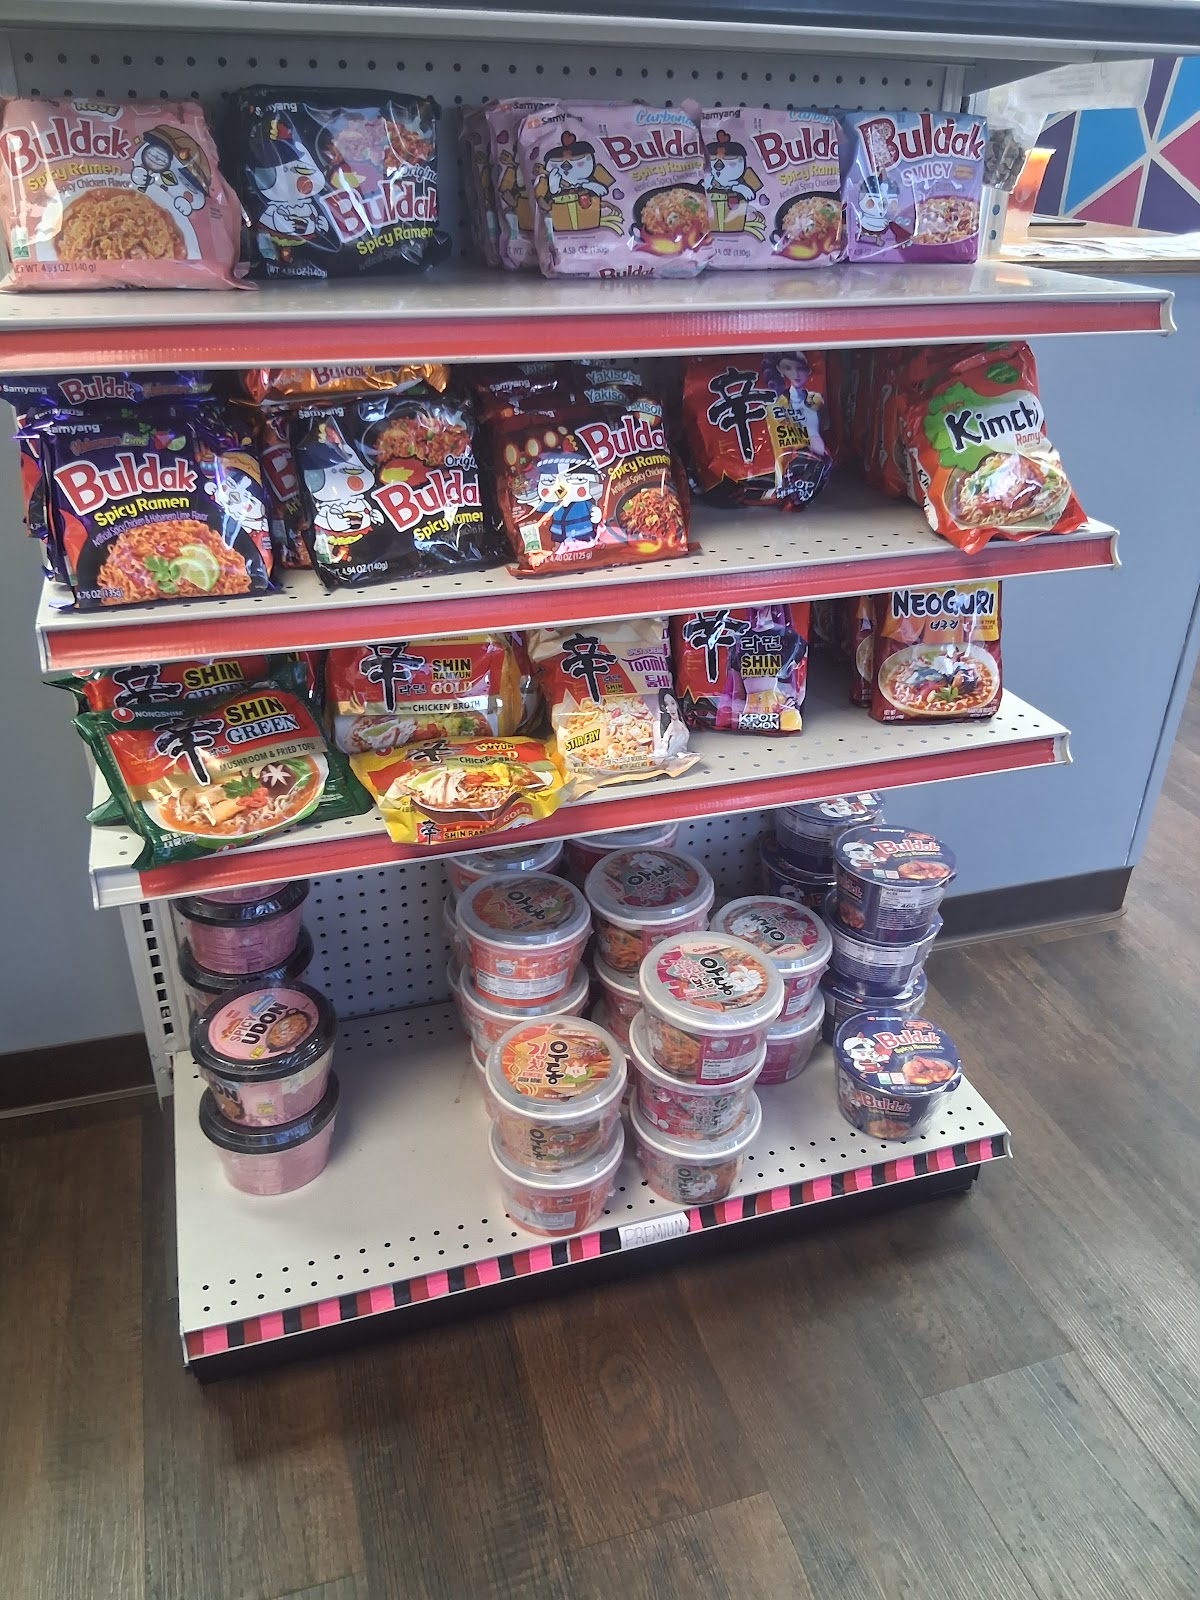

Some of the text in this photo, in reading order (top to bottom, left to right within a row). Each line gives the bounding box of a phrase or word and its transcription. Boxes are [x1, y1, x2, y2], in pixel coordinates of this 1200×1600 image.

[0, 117, 131, 179] Buldak
[857, 113, 985, 175] Buldak
[69, 162, 123, 176] Ramen
[320, 180, 438, 243] Buldak
[356, 227, 433, 255] Spicy Ramen
[3, 376, 136, 405] Samyang Buldak
[586, 369, 642, 386] Yakisoba
[707, 366, 778, 464] 辛
[944, 401, 1040, 453] Kimchi
[776, 425, 809, 439] SHIN
[54, 452, 198, 516] Buldak
[94, 496, 190, 527] Spicy Ramen
[413, 520, 448, 541] Spicy
[76, 590, 91, 600] 4.76
[892, 589, 995, 617] NEOGURI
[682, 610, 751, 683] 辛
[741, 635, 782, 654] 라면
[183, 661, 244, 689] SHIN
[431, 658, 471, 672] SHIN
[433, 671, 471, 680] RAMYUN
[560, 633, 617, 704] 辛
[742, 655, 781, 668] SHIN
[359, 642, 425, 713] 辛
[398, 684, 427, 696] 라면
[135, 710, 184, 718] NONGSHIM
[224, 697, 286, 725] SHIN
[412, 699, 481, 712] CHICKEN BROTH
[225, 715, 300, 745] GREEN
[565, 733, 585, 751] STIR
[219, 752, 268, 772] MUSHROOM
[277, 746, 297, 757] FRIED
[298, 742, 315, 753] TOFU
[445, 829, 466, 839] SHIN
[873, 838, 940, 854] Buldak
[230, 1015, 257, 1041] SPICY
[242, 1002, 288, 1045] UDON
[873, 1030, 941, 1049] Buldak
[526, 1042, 547, 1071] 김치
[545, 1041, 569, 1085] 우동
[860, 1090, 912, 1112] Buldak
[624, 1219, 684, 1247] PREMIUM
